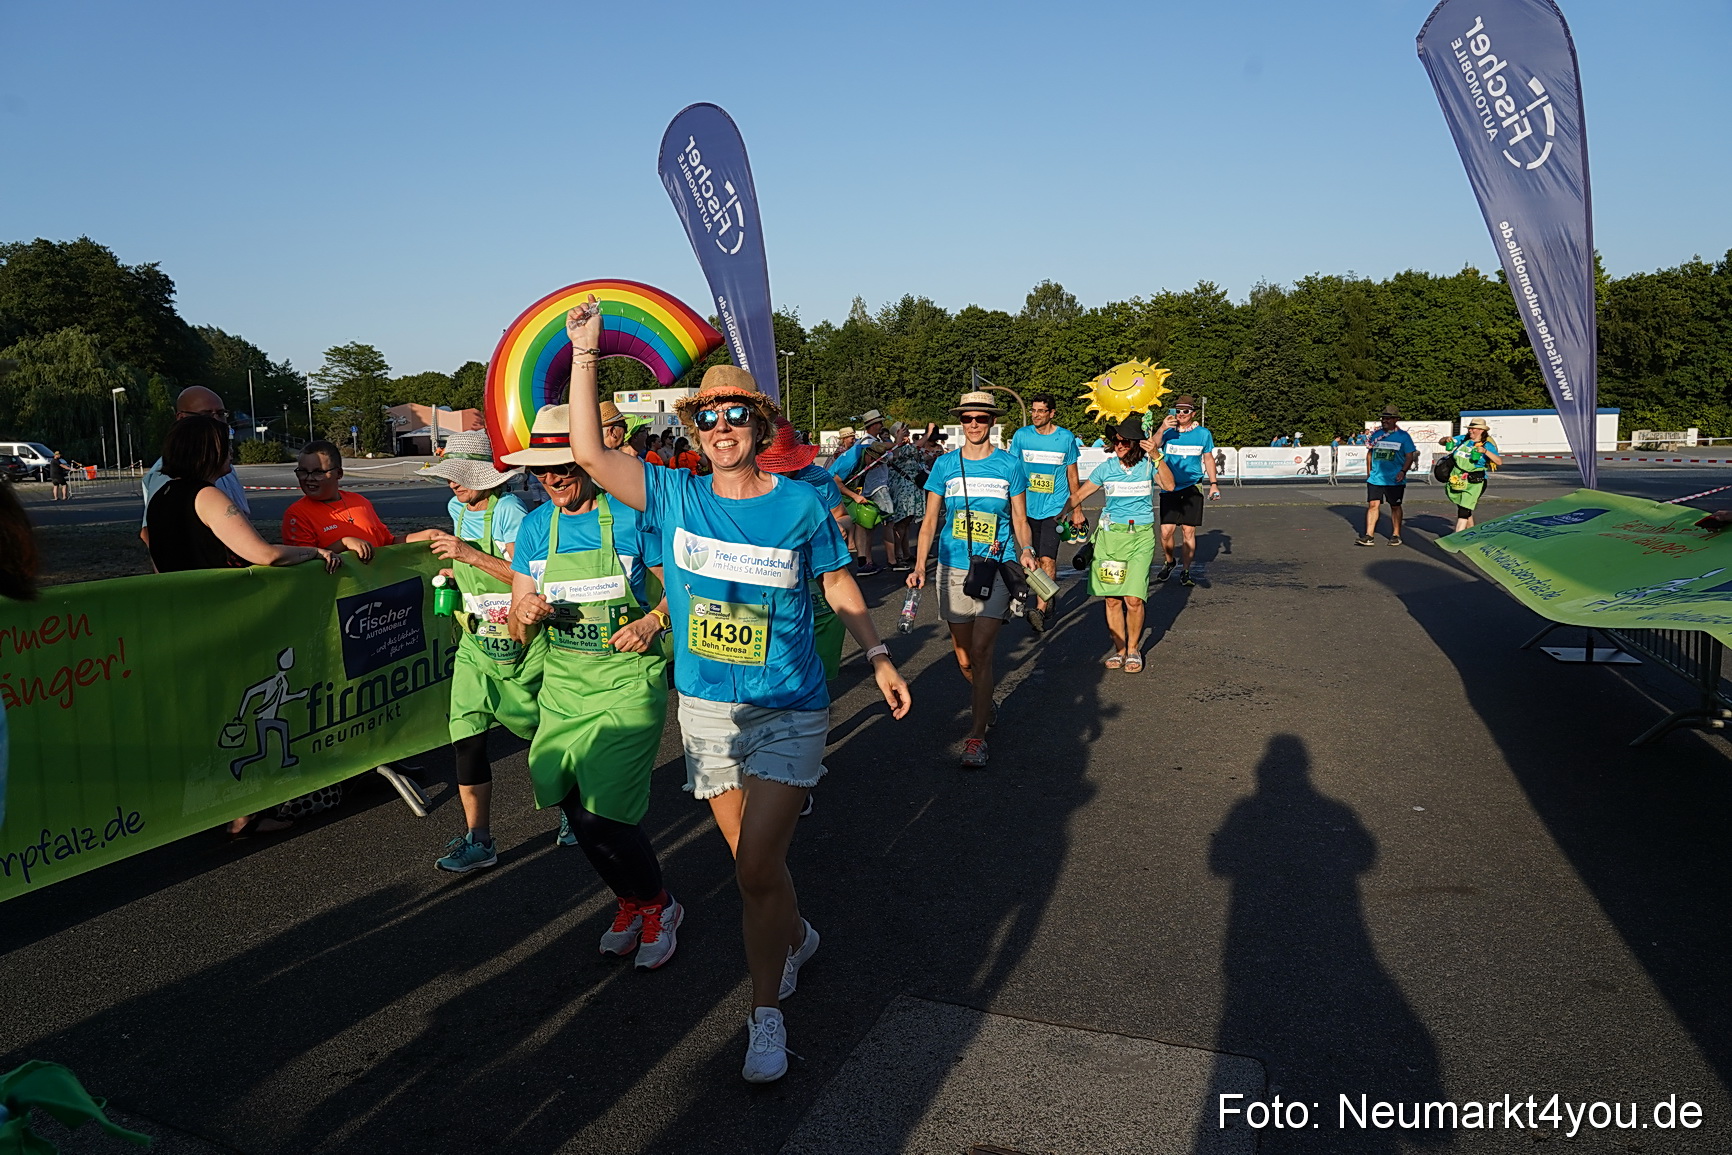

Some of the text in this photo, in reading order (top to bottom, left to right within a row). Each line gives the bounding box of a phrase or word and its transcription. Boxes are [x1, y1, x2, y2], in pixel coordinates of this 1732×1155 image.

[1033, 479, 1050, 488] 1433
[323, 524, 338, 532] JAKO
[714, 550, 738, 563] Freie
[712, 561, 782, 578] im Haus St. Marien
[583, 582, 619, 592] Grundschule
[359, 605, 413, 634] Fischer
[365, 619, 407, 640] AUTOMOBILE
[557, 622, 599, 640] 1438
[0, 613, 93, 658] rmen
[600, 625, 609, 649] 2022
[691, 619, 699, 647] WALK
[699, 619, 753, 646] 1430
[753, 629, 763, 657] 2022
[701, 640, 720, 650] Dehn
[721, 644, 747, 654] Teresa
[0, 637, 132, 710] änger!
[307, 638, 457, 732] firmenla
[312, 703, 402, 754] neumarkt
[0, 806, 146, 884] rpfalz.de
